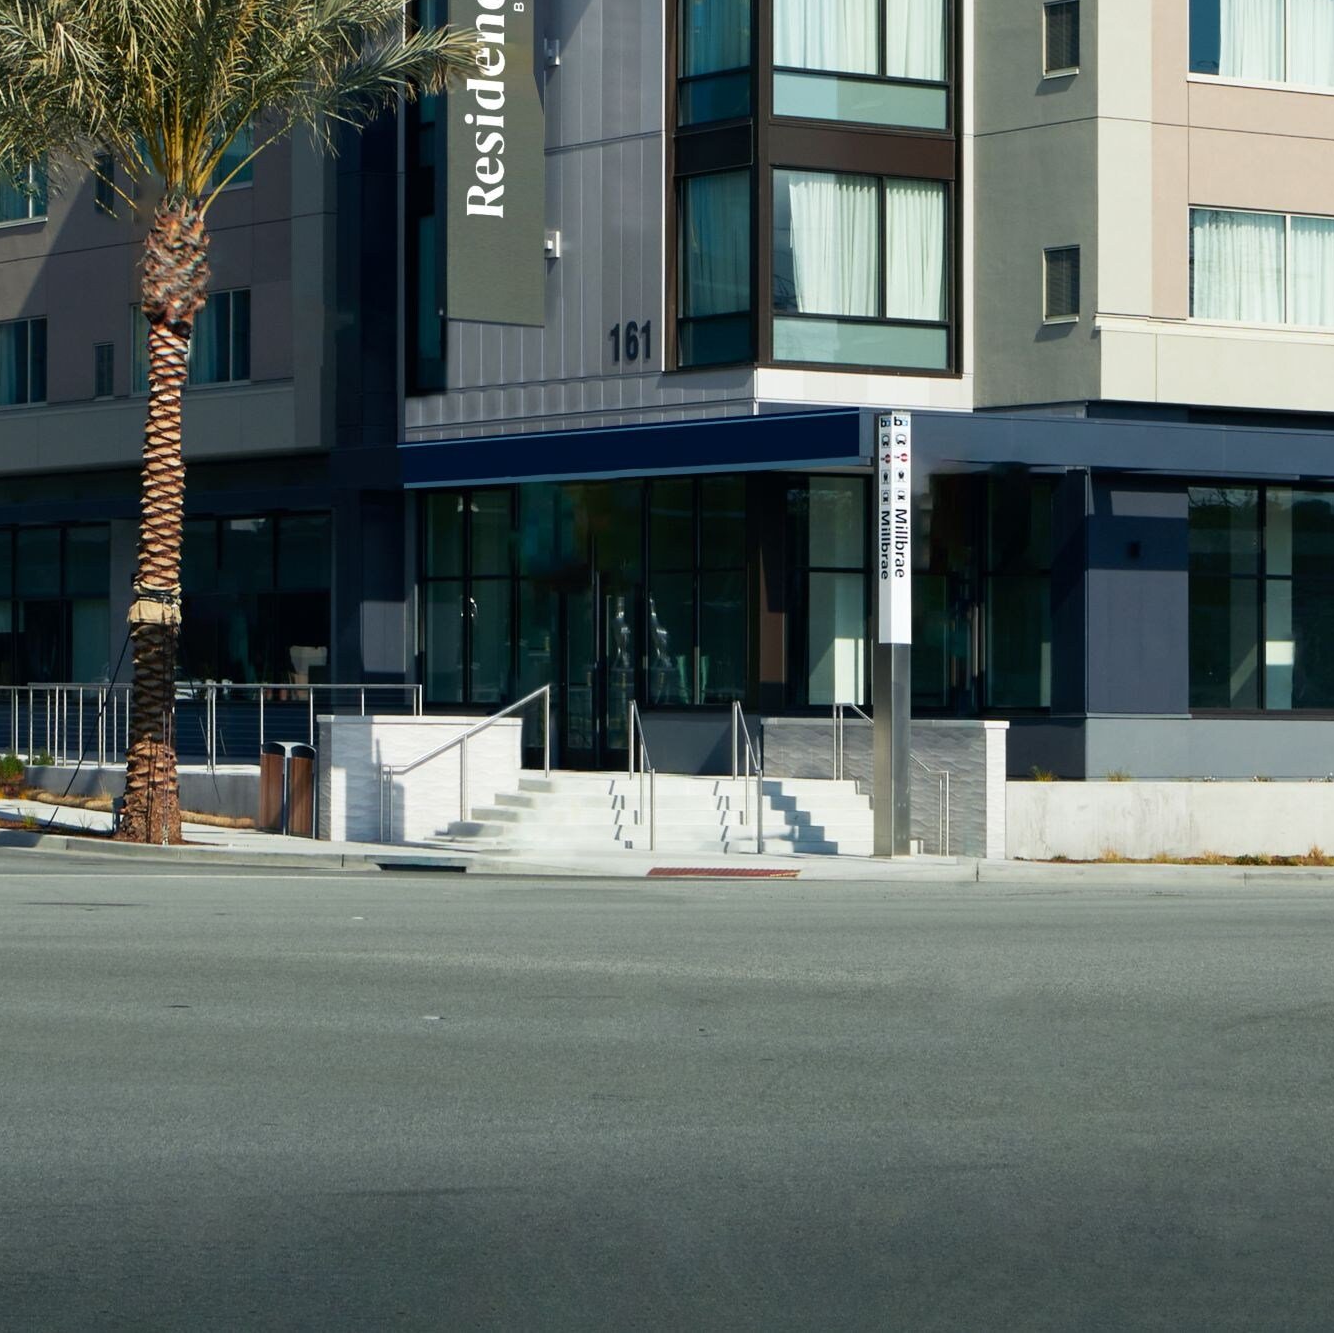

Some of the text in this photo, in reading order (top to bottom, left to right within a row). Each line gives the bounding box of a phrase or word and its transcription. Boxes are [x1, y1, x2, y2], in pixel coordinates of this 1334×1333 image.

[610, 320, 651, 362] 161
[881, 510, 891, 580] Millbrae
[895, 509, 908, 578] Millbrae
